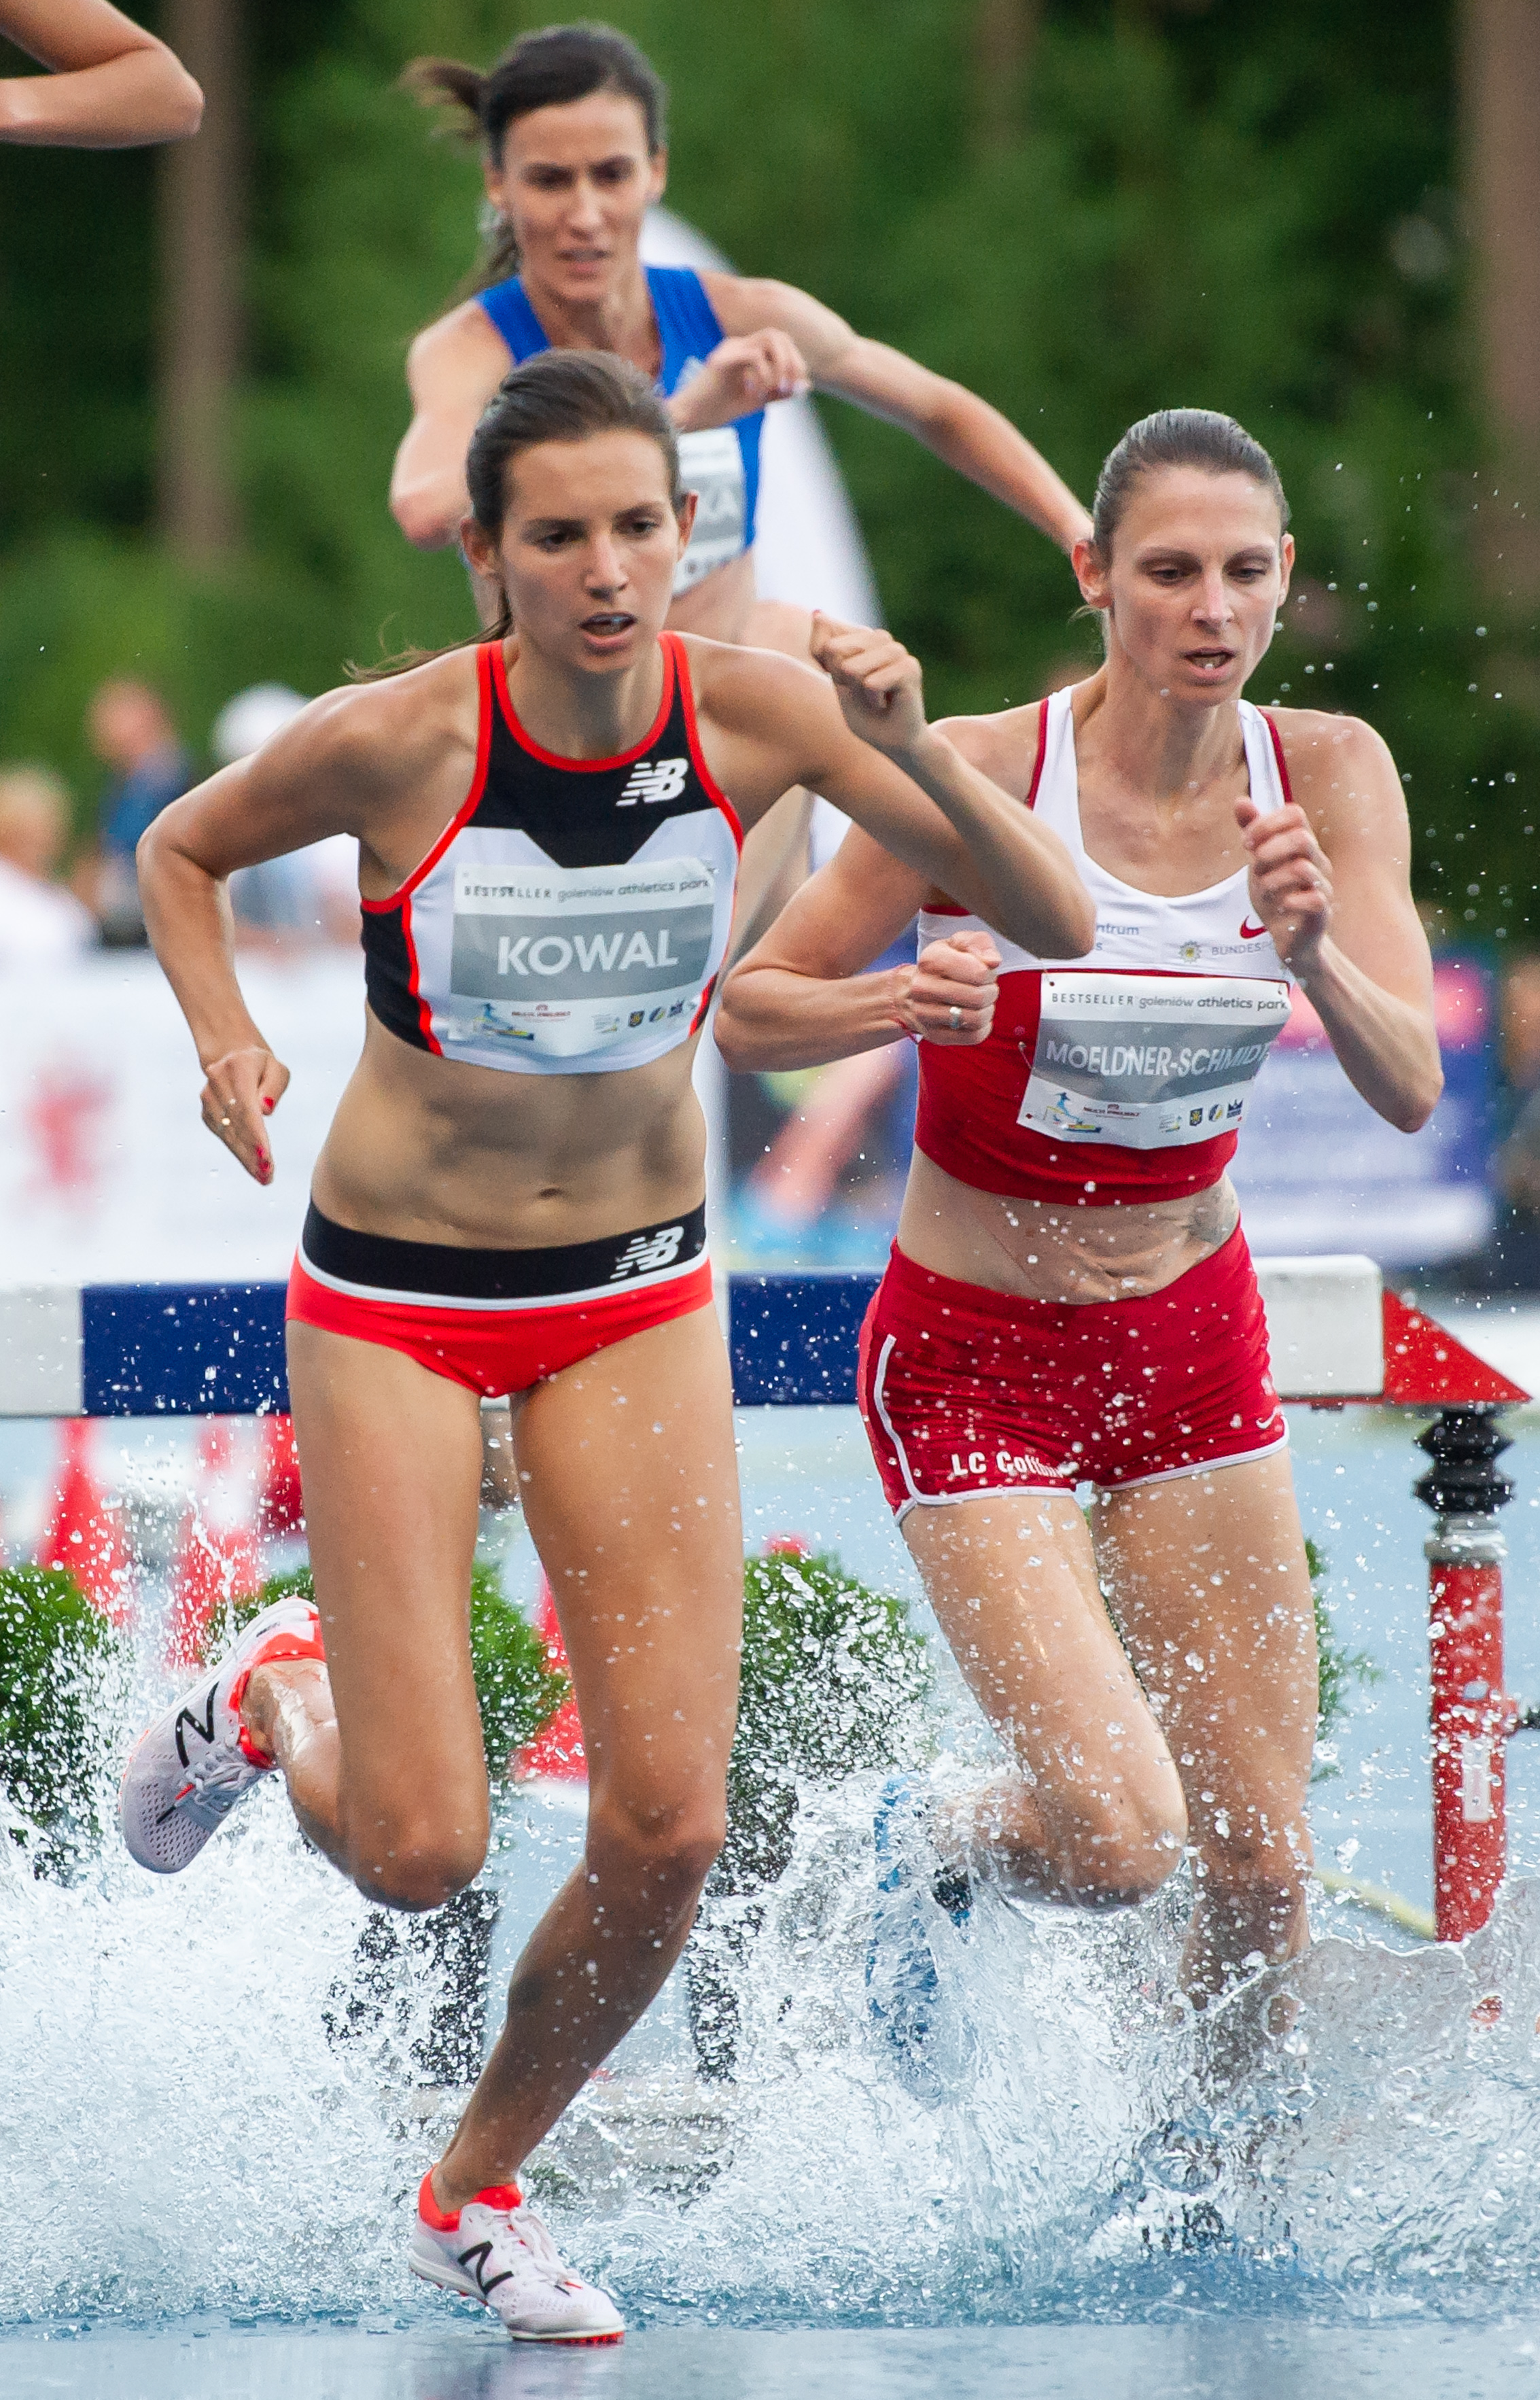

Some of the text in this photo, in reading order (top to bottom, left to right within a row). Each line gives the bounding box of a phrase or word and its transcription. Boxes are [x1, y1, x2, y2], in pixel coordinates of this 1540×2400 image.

[463, 884, 552, 899] BESTSELLER
[617, 880, 676, 895] athletics
[1096, 922, 1140, 936] ntrum
[497, 928, 679, 976] KOWAL
[1211, 941, 1274, 956] BUNDESP
[1051, 992, 1287, 1011] BESTSELLER goleniów athletics park
[951, 1451, 1068, 1478] LC Cottbu
